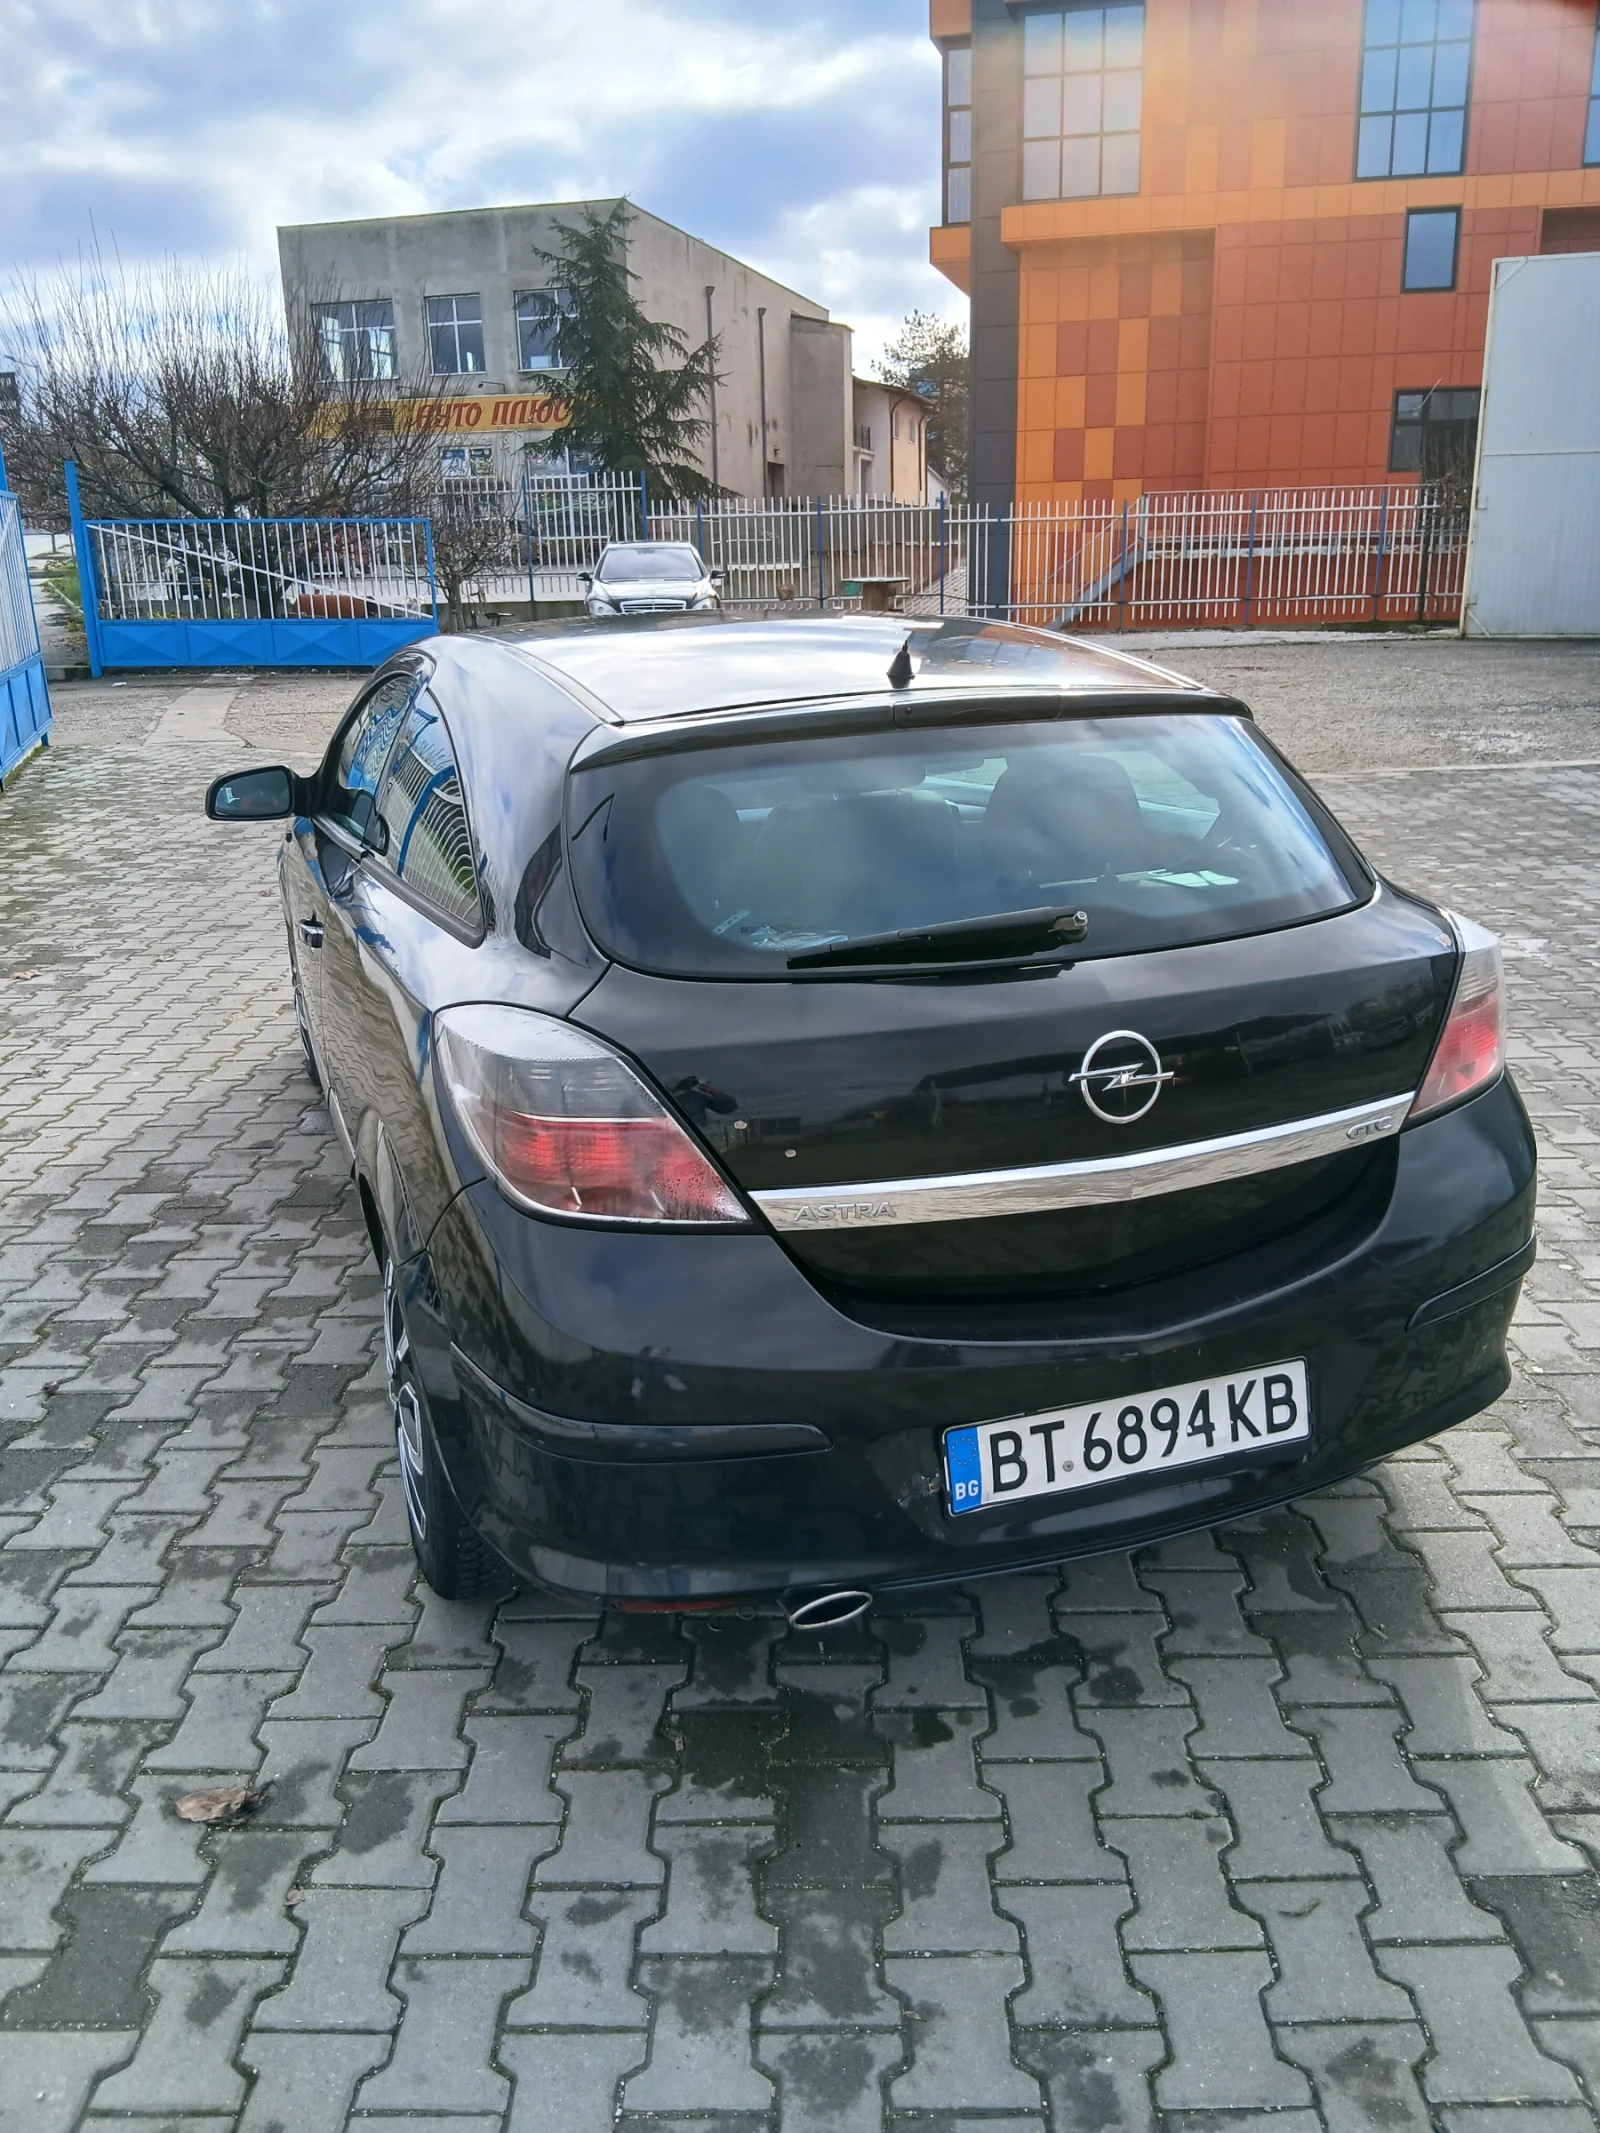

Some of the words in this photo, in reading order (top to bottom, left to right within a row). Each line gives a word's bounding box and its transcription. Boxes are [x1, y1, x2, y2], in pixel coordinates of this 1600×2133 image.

[491, 398, 571, 425] ПЛЮС
[1346, 1116, 1393, 1139] GTC
[793, 1201, 897, 1222] ASTRA
[989, 1420, 1065, 1493] BT
[1083, 1389, 1215, 1472] 6894
[1227, 1373, 1298, 1442] KB
[955, 1480, 979, 1500] BG
